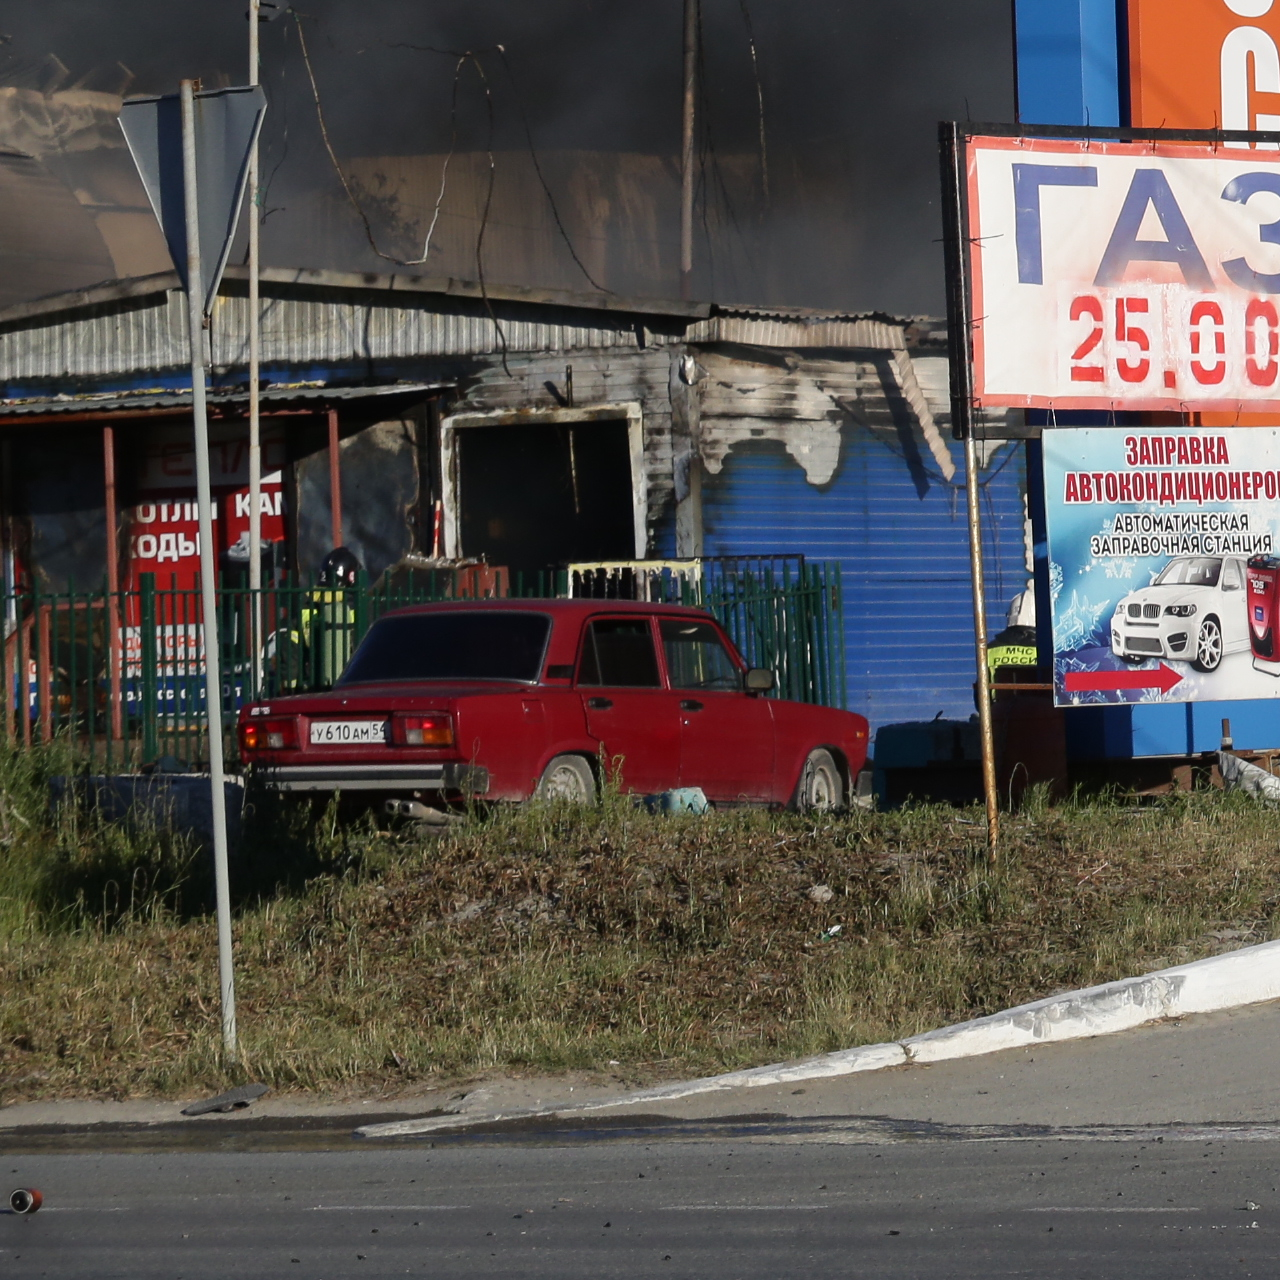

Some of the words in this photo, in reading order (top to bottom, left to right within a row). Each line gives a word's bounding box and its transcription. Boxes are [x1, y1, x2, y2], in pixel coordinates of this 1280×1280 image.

[1069, 295, 1279, 388] 25.00
[1125, 435, 1230, 466] ЗАПРАВКА
[1114, 514, 1249, 533] АВТОМАТИЧЕСКАЯ
[1091, 535, 1200, 556] ЗАПРАВОЧНАЯ
[1203, 533, 1272, 555] СТАНЦИЯ
[1006, 646, 1034, 656] МЧС
